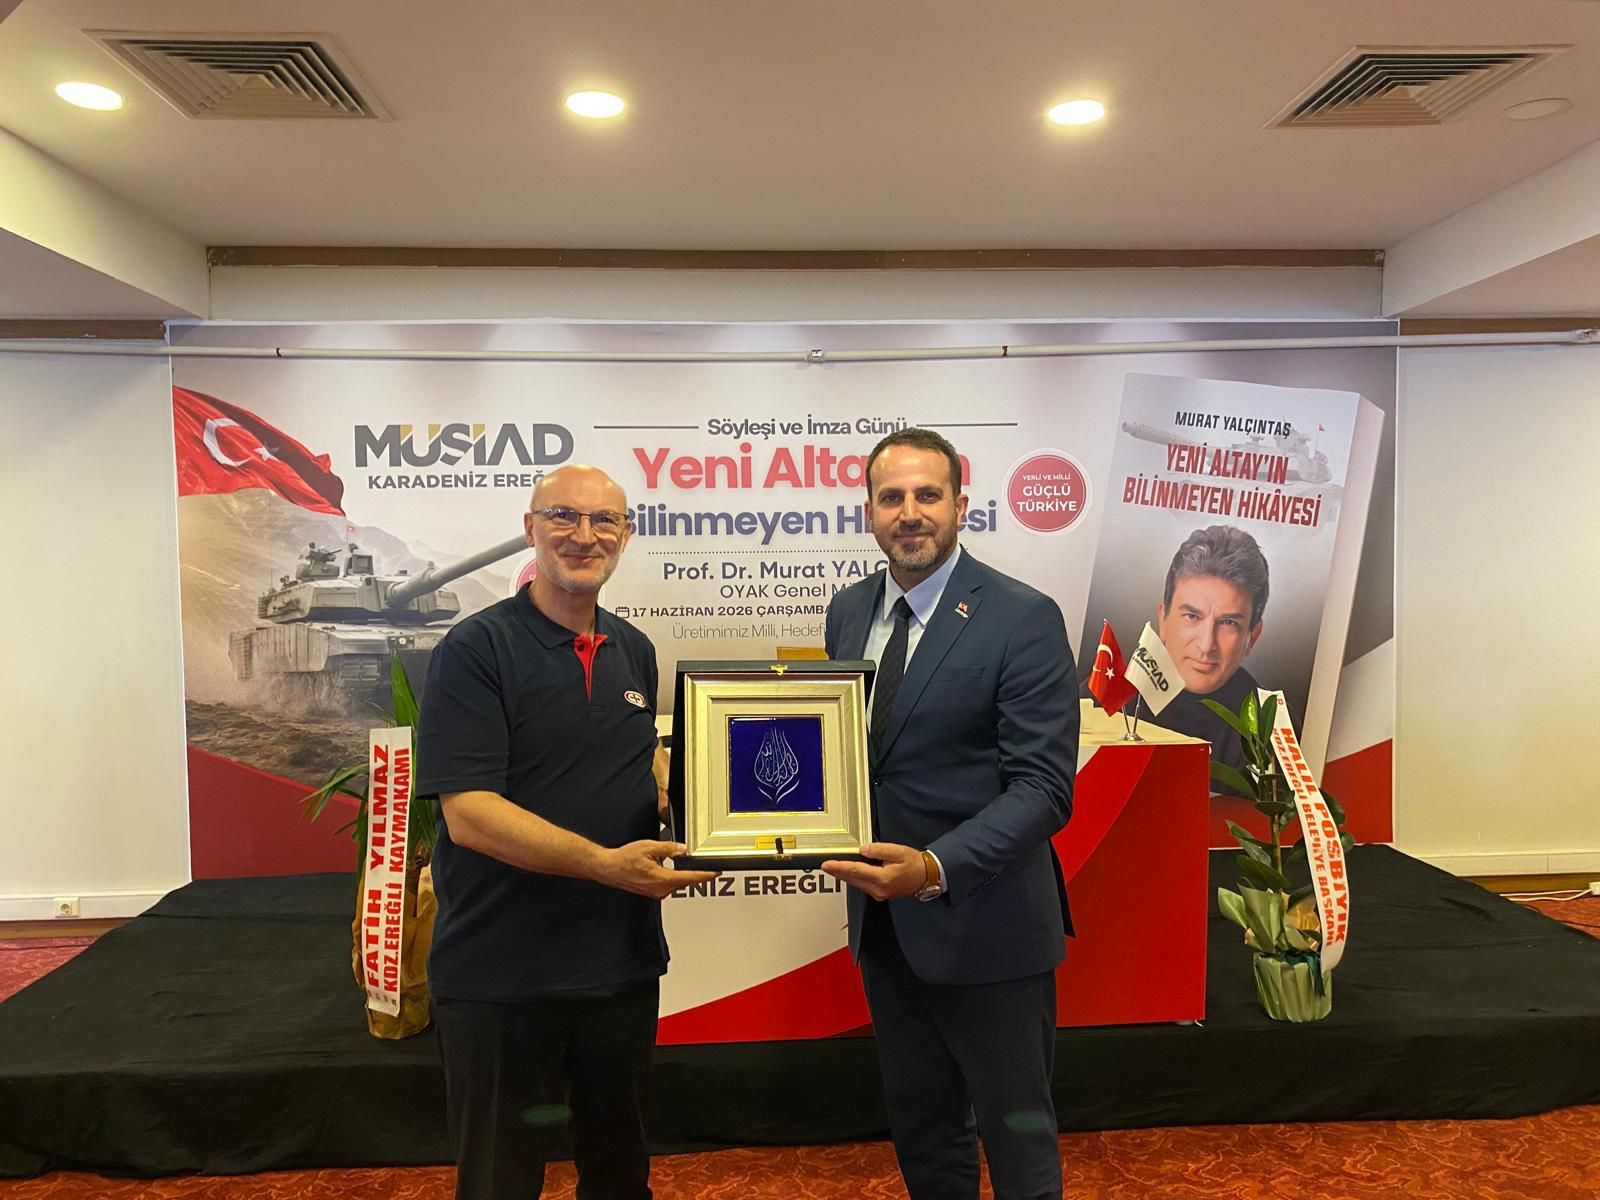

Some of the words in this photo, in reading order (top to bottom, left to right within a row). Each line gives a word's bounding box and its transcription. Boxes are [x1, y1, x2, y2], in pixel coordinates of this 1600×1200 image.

[707, 418, 775, 439] Söyleşi
[780, 421, 803, 435] ve
[807, 414, 851, 435] İmza
[855, 417, 907, 434] Günü
[1175, 411, 1220, 430] MURAT
[1223, 416, 1291, 440] YALÇINTAŞ
[632, 442, 753, 489] Yeni
[1166, 442, 1208, 475] YENİ
[1209, 448, 1289, 485] ALTAY'IN
[368, 471, 488, 489] KARADENİZ
[493, 470, 544, 488] EREĞ
[1022, 483, 1071, 499] GÜÇLÜ
[1016, 498, 1077, 512] TÜRKİYE
[1122, 473, 1235, 516] BİLİNMEYEN
[1237, 486, 1322, 527] HİKÂYESİ
[663, 562, 714, 580] Prof.
[721, 561, 752, 579] Dr.
[760, 561, 825, 579] Murat
[720, 584, 769, 598] OYAK
[774, 583, 826, 598] Genel
[632, 607, 645, 617] 17
[650, 605, 714, 617] HAZİRAN
[718, 606, 753, 616] 2026
[672, 622, 749, 639] Üretimimiz
[370, 744, 389, 871] YILMAZ
[389, 747, 410, 873] KAYMAKAMI
[364, 889, 382, 988] FATİH
